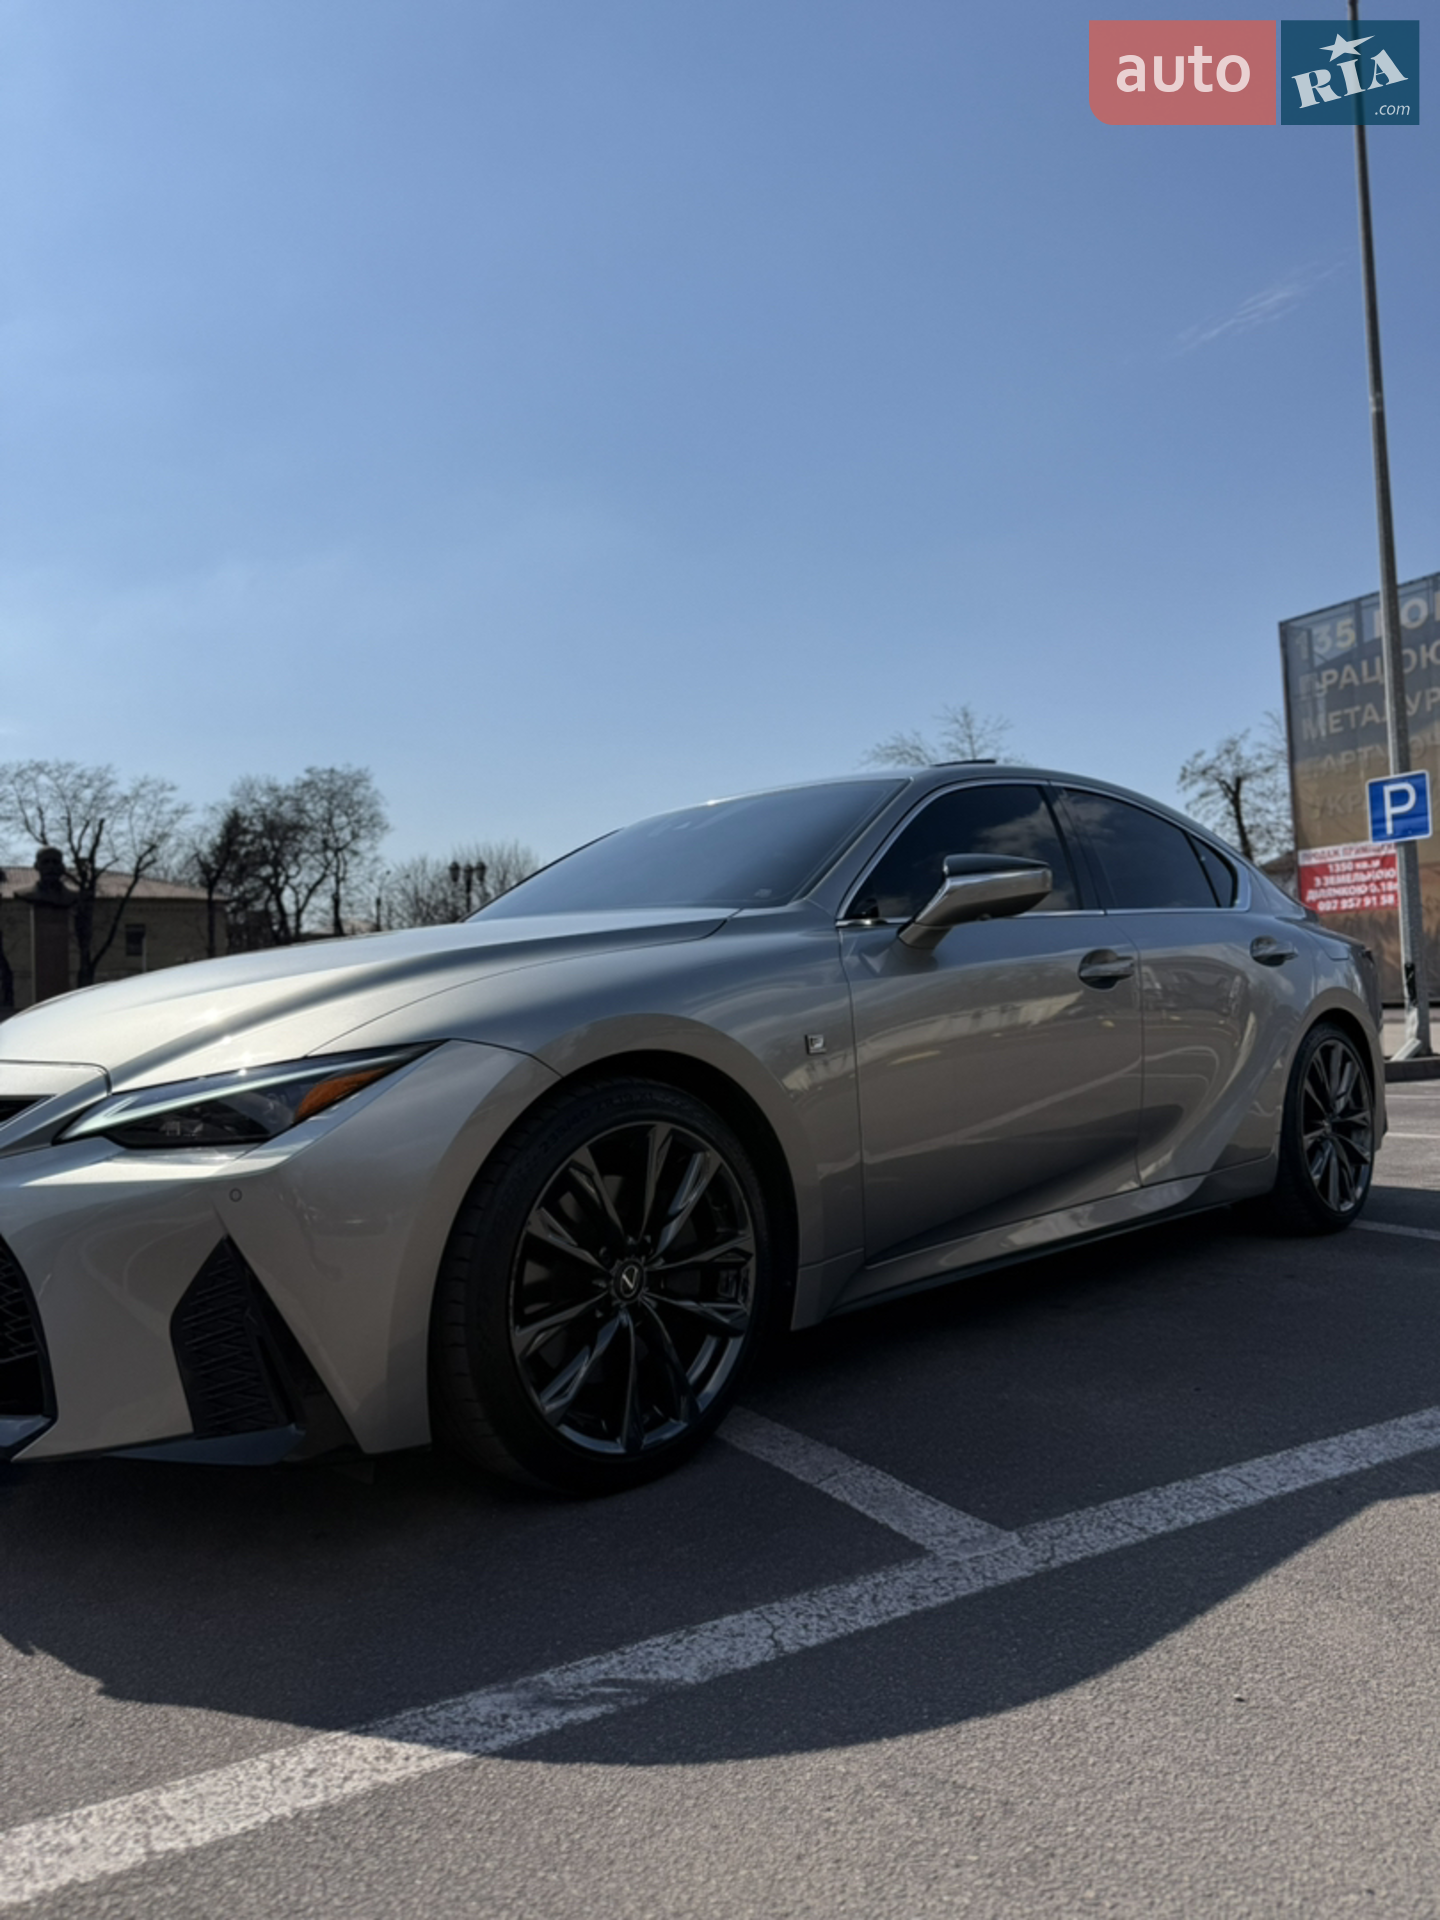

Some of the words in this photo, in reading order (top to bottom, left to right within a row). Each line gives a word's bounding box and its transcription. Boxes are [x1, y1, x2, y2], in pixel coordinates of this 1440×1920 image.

[1296, 616, 1356, 660] 135
[1302, 686, 1440, 741] МЕТАУР
[1383, 782, 1416, 836] P
